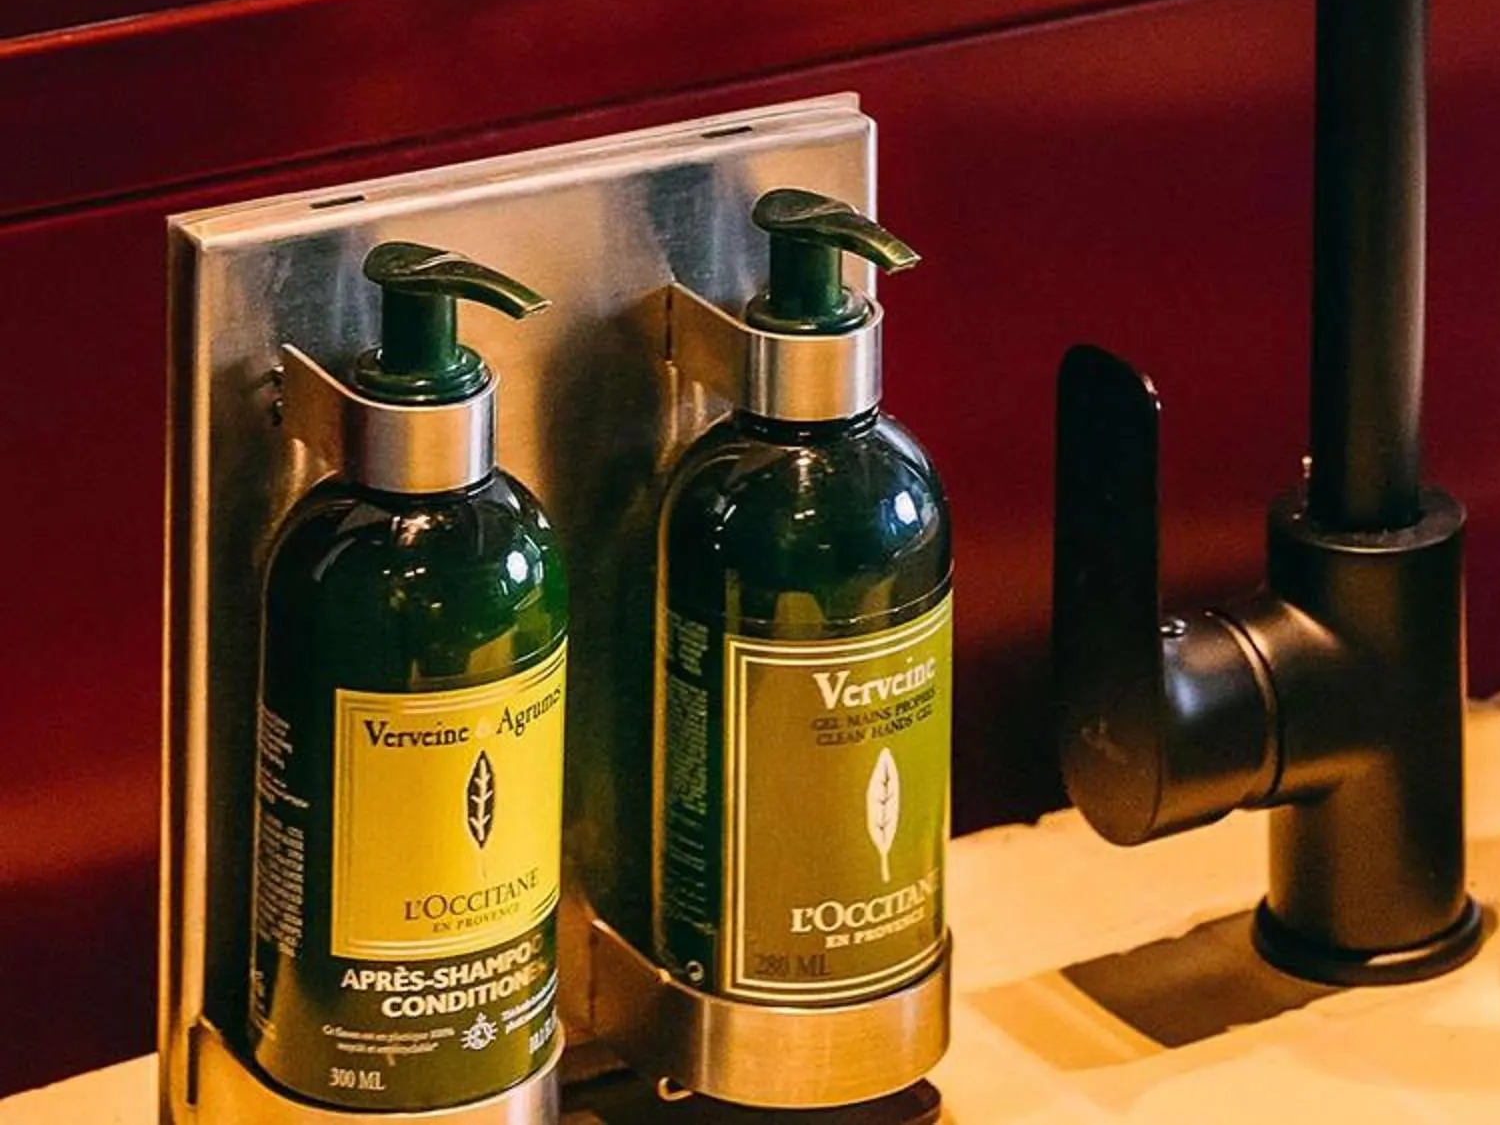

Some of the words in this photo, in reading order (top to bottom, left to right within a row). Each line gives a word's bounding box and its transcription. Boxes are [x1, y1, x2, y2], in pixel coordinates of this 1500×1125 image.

[812, 656, 936, 710] Verveine
[847, 706, 891, 727] MAINS
[363, 720, 470, 748] Verveine
[815, 728, 865, 746] CLEAN
[404, 866, 539, 921] L'OCCITANE
[432, 922, 451, 933] EN
[825, 933, 850, 949] EN
[328, 1066, 357, 1088] 300
[357, 1069, 387, 1091] ML
